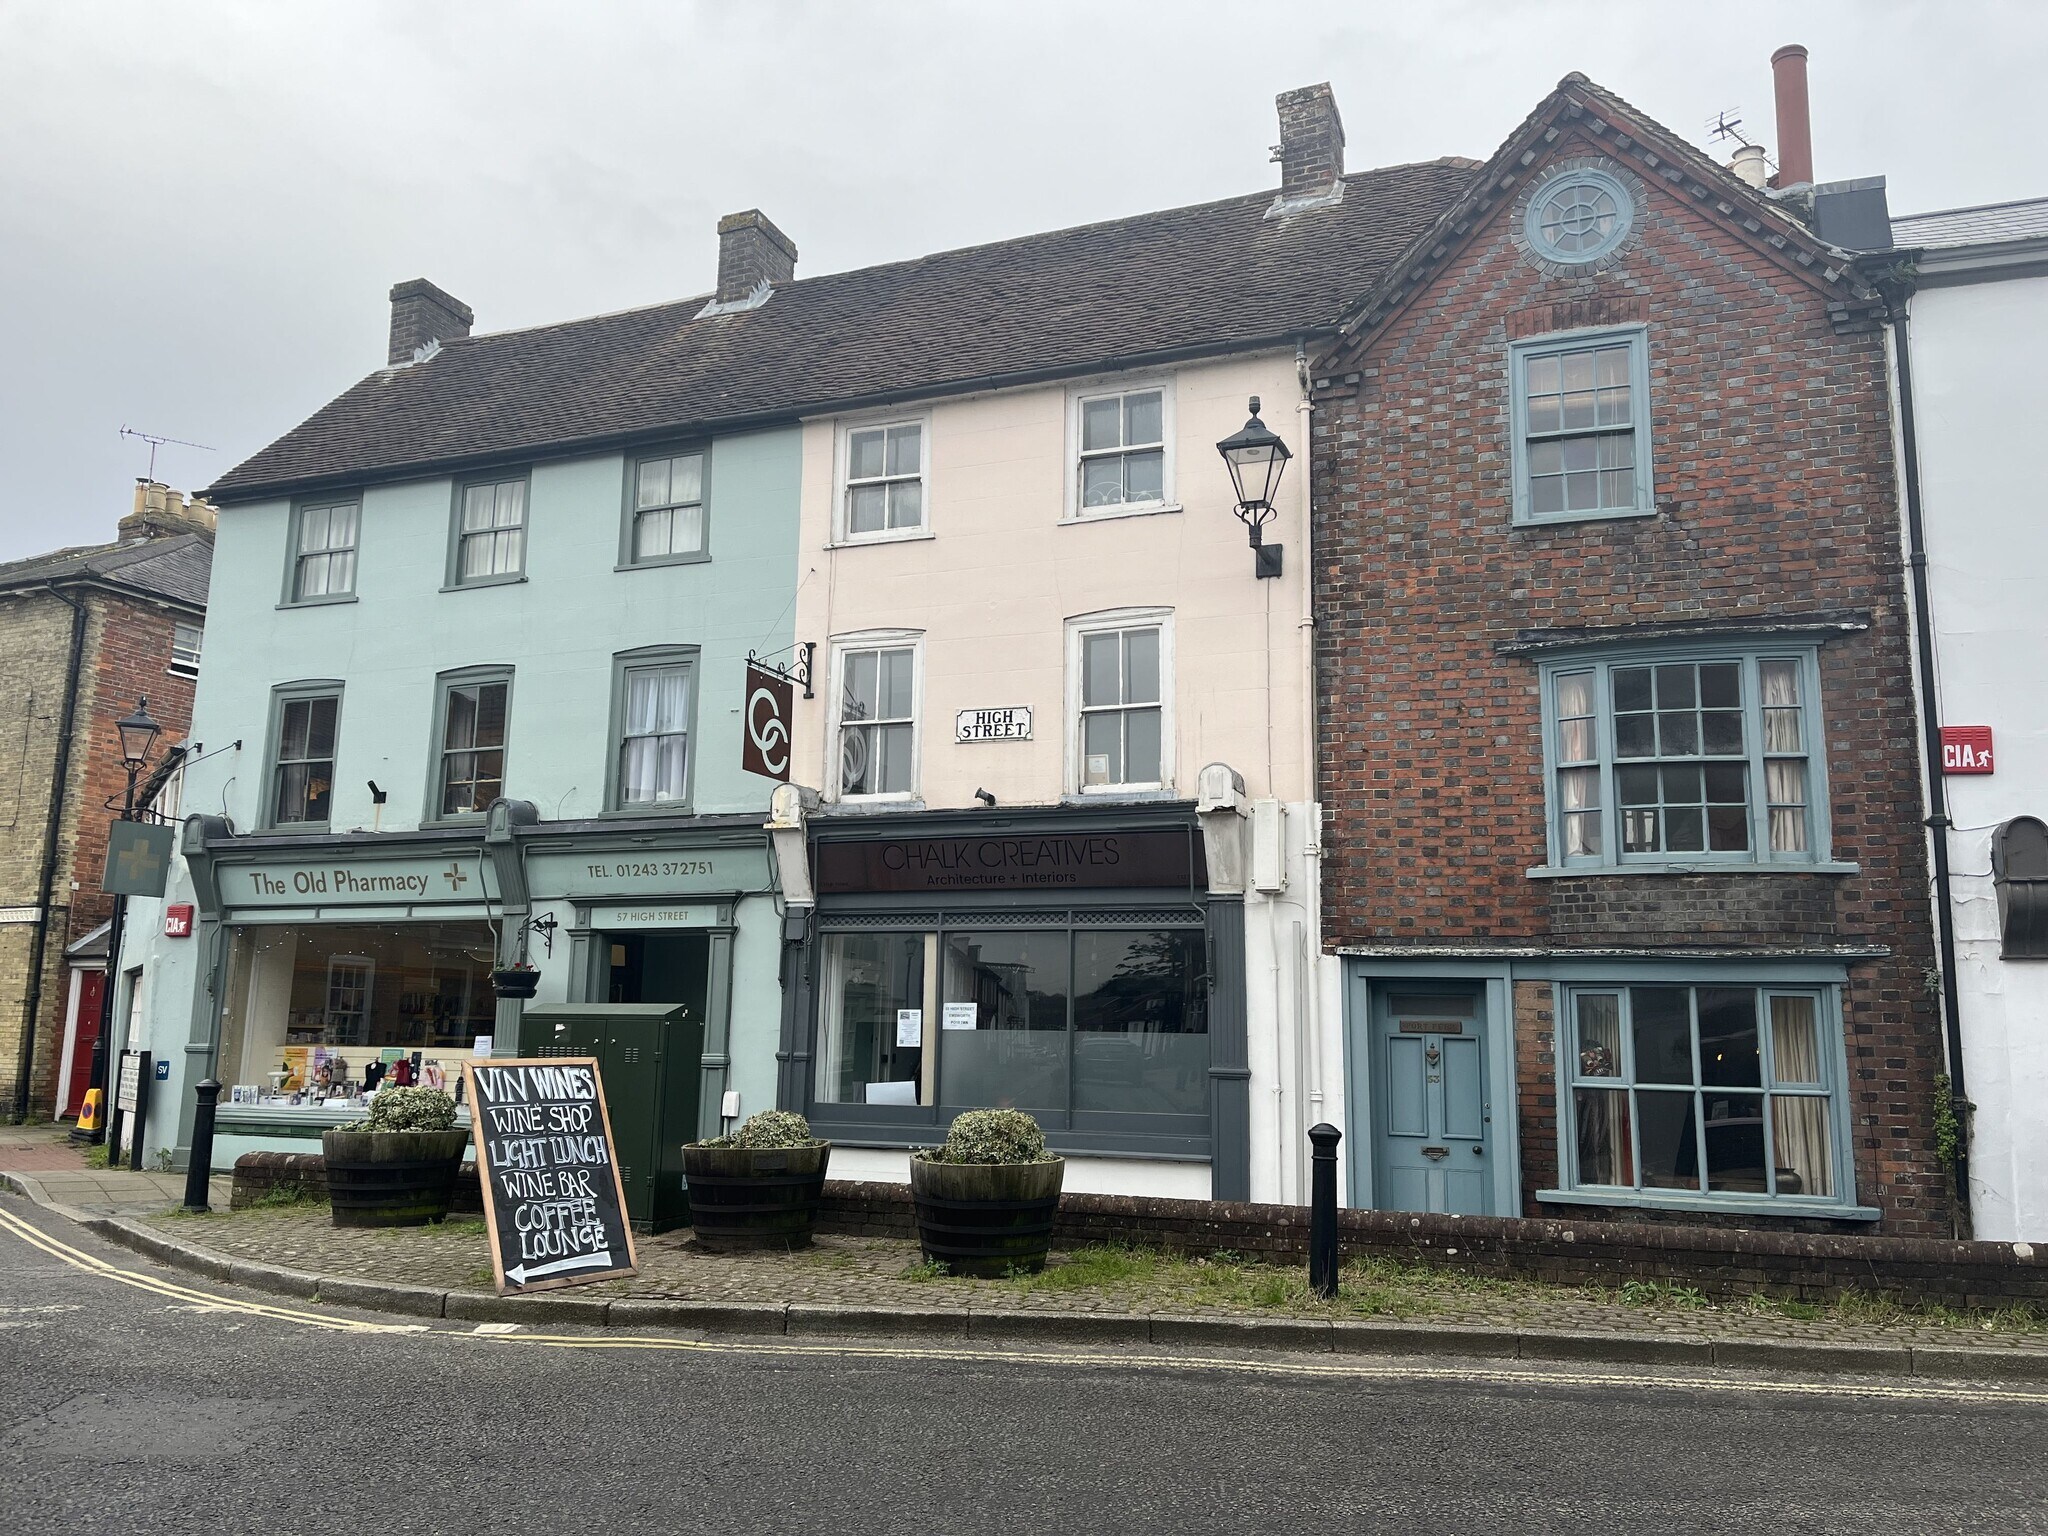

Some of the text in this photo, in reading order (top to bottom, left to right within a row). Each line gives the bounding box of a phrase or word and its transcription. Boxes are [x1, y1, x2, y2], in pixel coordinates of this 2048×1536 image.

[976, 710, 1013, 724] HIGH
[962, 722, 1026, 738] STREET
[1943, 744, 1975, 767] CIA
[882, 837, 1120, 871] CHALK CREATIVES
[587, 861, 714, 878] TEL. 01243 372751
[927, 873, 1006, 886] Architecture
[1022, 870, 1076, 884] Interiors
[249, 870, 428, 897] The Old Pharmacy
[165, 917, 178, 933] CIA
[616, 911, 699, 921] 57 HIGH STREET
[157, 1065, 168, 1074] SV
[474, 1066, 596, 1103] VIN WINES
[490, 1104, 593, 1133] WINE SHOP
[488, 1135, 609, 1168] LIGHT LUNCH
[501, 1170, 598, 1198] WINE BAR
[514, 1198, 609, 1260] COFFEE LOUNGE
